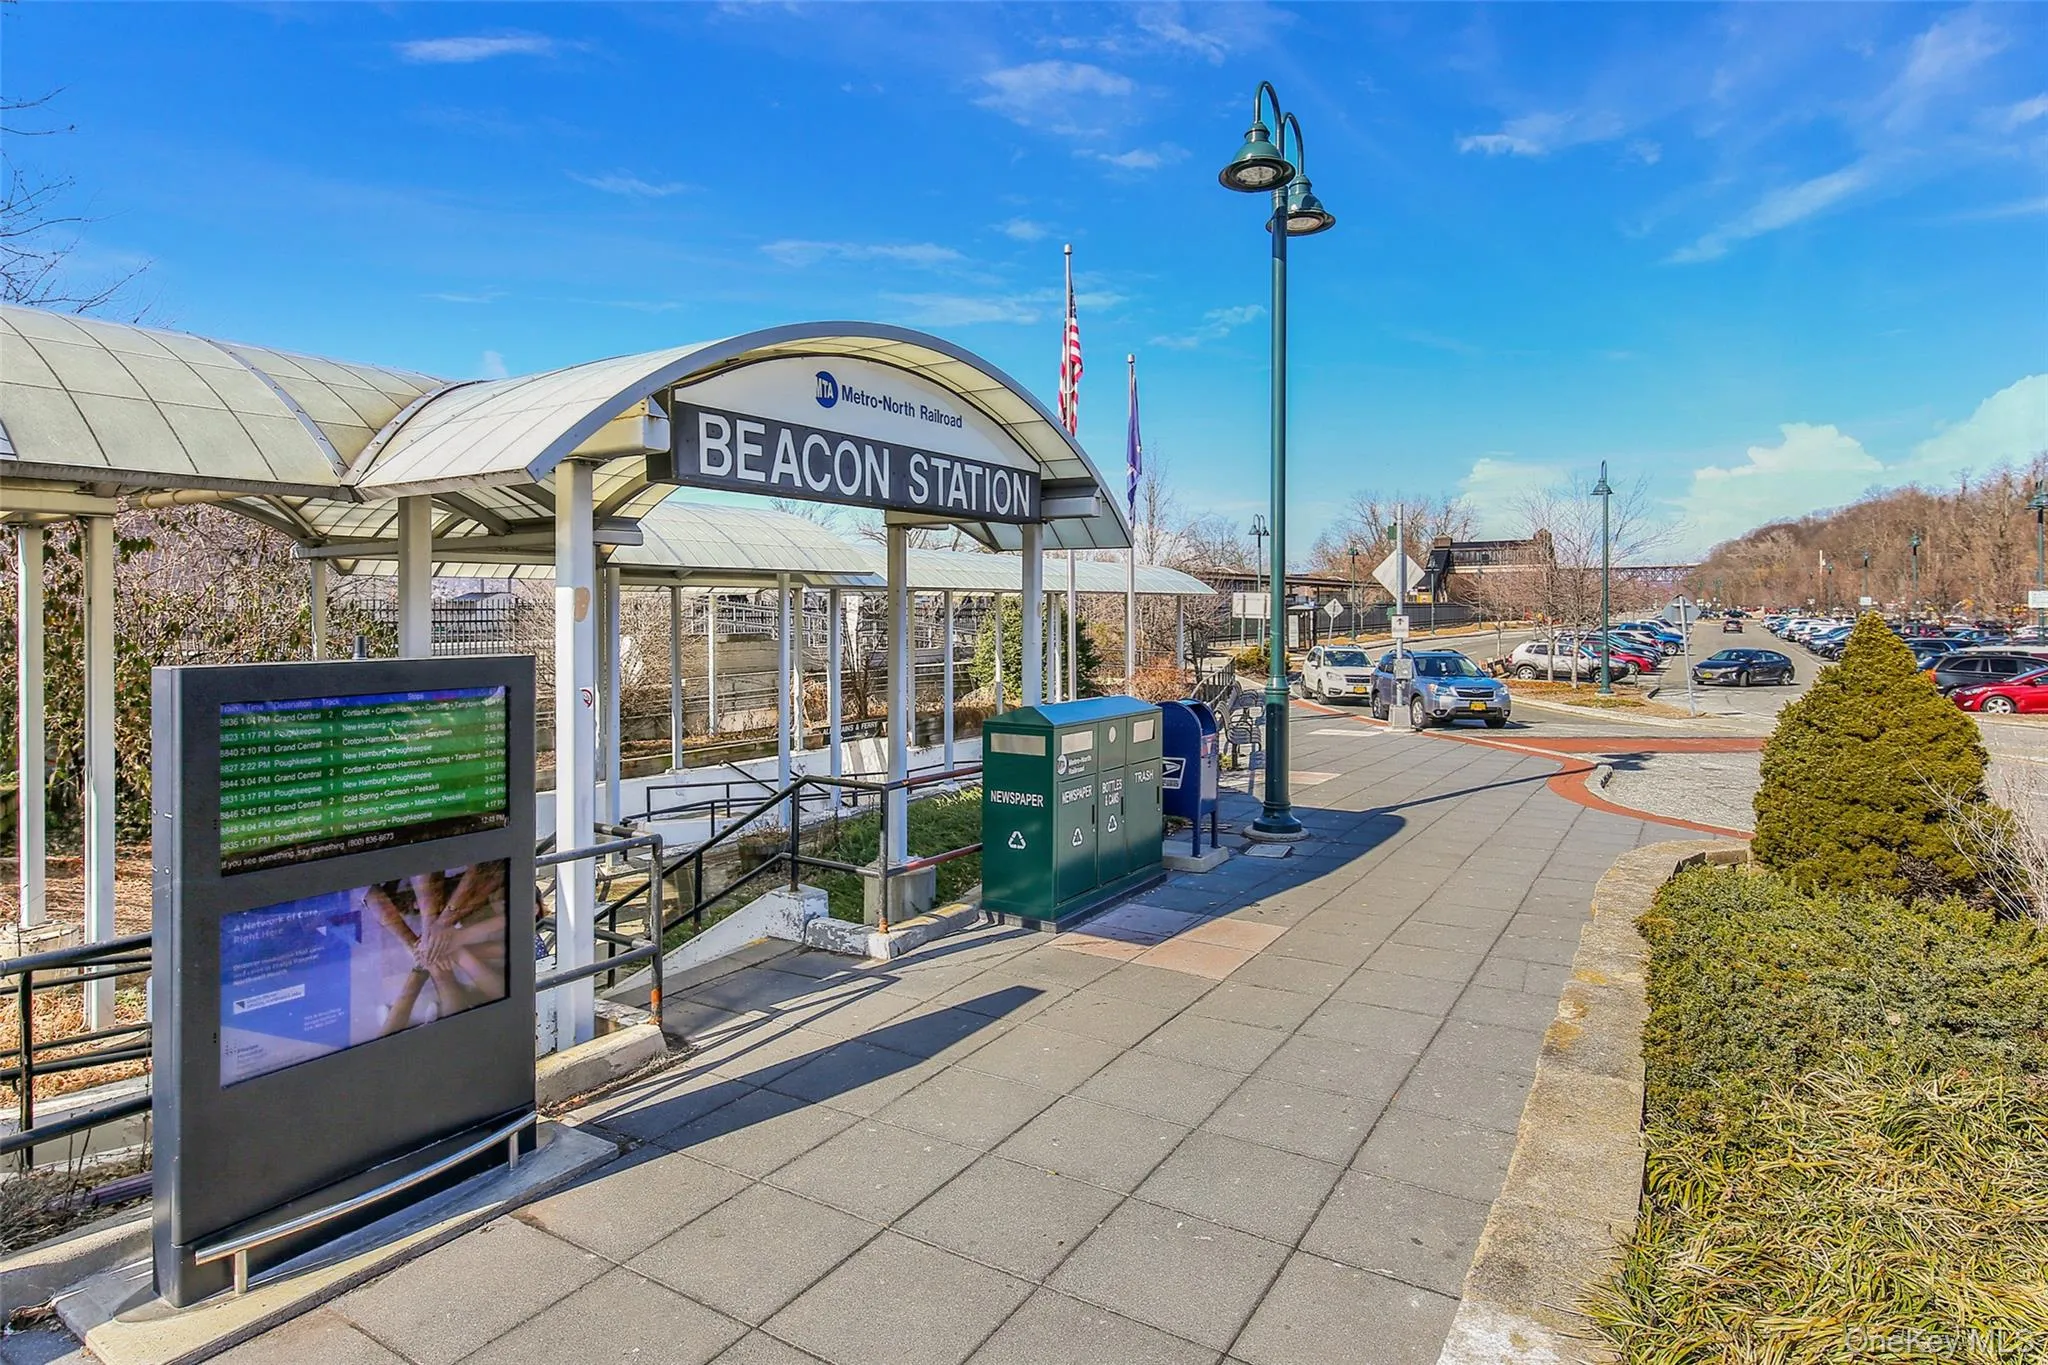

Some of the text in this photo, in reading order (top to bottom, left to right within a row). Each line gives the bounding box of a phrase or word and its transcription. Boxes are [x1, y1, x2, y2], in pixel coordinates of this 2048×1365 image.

[841, 384, 964, 429] Metro-North Railroad
[699, 412, 1031, 518] BEACON STATION
[321, 698, 339, 706] Track
[257, 715, 270, 723] PM
[273, 714, 296, 722] Grand
[296, 712, 321, 720] Central
[257, 730, 270, 738] PM
[273, 726, 322, 738] Poughkeepsie
[342, 723, 356, 731] New
[257, 745, 270, 753] PM
[273, 743, 296, 752] Grand
[296, 741, 321, 750] Central
[328, 739, 334, 747] 1
[342, 734, 389, 745] Croton-Harmon
[257, 760, 270, 769] PM
[273, 755, 322, 768] Poughkeepsie
[342, 752, 356, 760] New
[257, 775, 270, 784] PM
[273, 772, 296, 782] Grand
[296, 769, 321, 779] Central
[328, 768, 334, 776] 2
[1134, 769, 1154, 783] TRASH
[257, 790, 270, 799] PM
[273, 784, 322, 799] Poughkeepsie
[328, 783, 334, 791] 1
[342, 780, 356, 789] New
[1061, 785, 1093, 805] NEWSPAPER
[1102, 779, 1123, 794] BOTTLES
[257, 805, 270, 814] PM
[273, 802, 296, 812] Grand
[296, 799, 321, 809] Central
[328, 797, 334, 805] 2
[342, 794, 358, 803] Cold
[358, 790, 379, 801] Spring
[990, 790, 1044, 807] NEWSPAPER
[257, 820, 270, 829] PM
[273, 817, 296, 827] Grand
[296, 813, 321, 824] Central
[342, 809, 358, 817] Cold
[358, 804, 379, 816] Spring
[257, 835, 270, 844] PM
[273, 828, 322, 843] Poughkeepsie
[328, 826, 334, 834] 1
[342, 823, 356, 832] New
[227, 859, 242, 869] you
[243, 856, 257, 865] see
[310, 841, 345, 855] something
